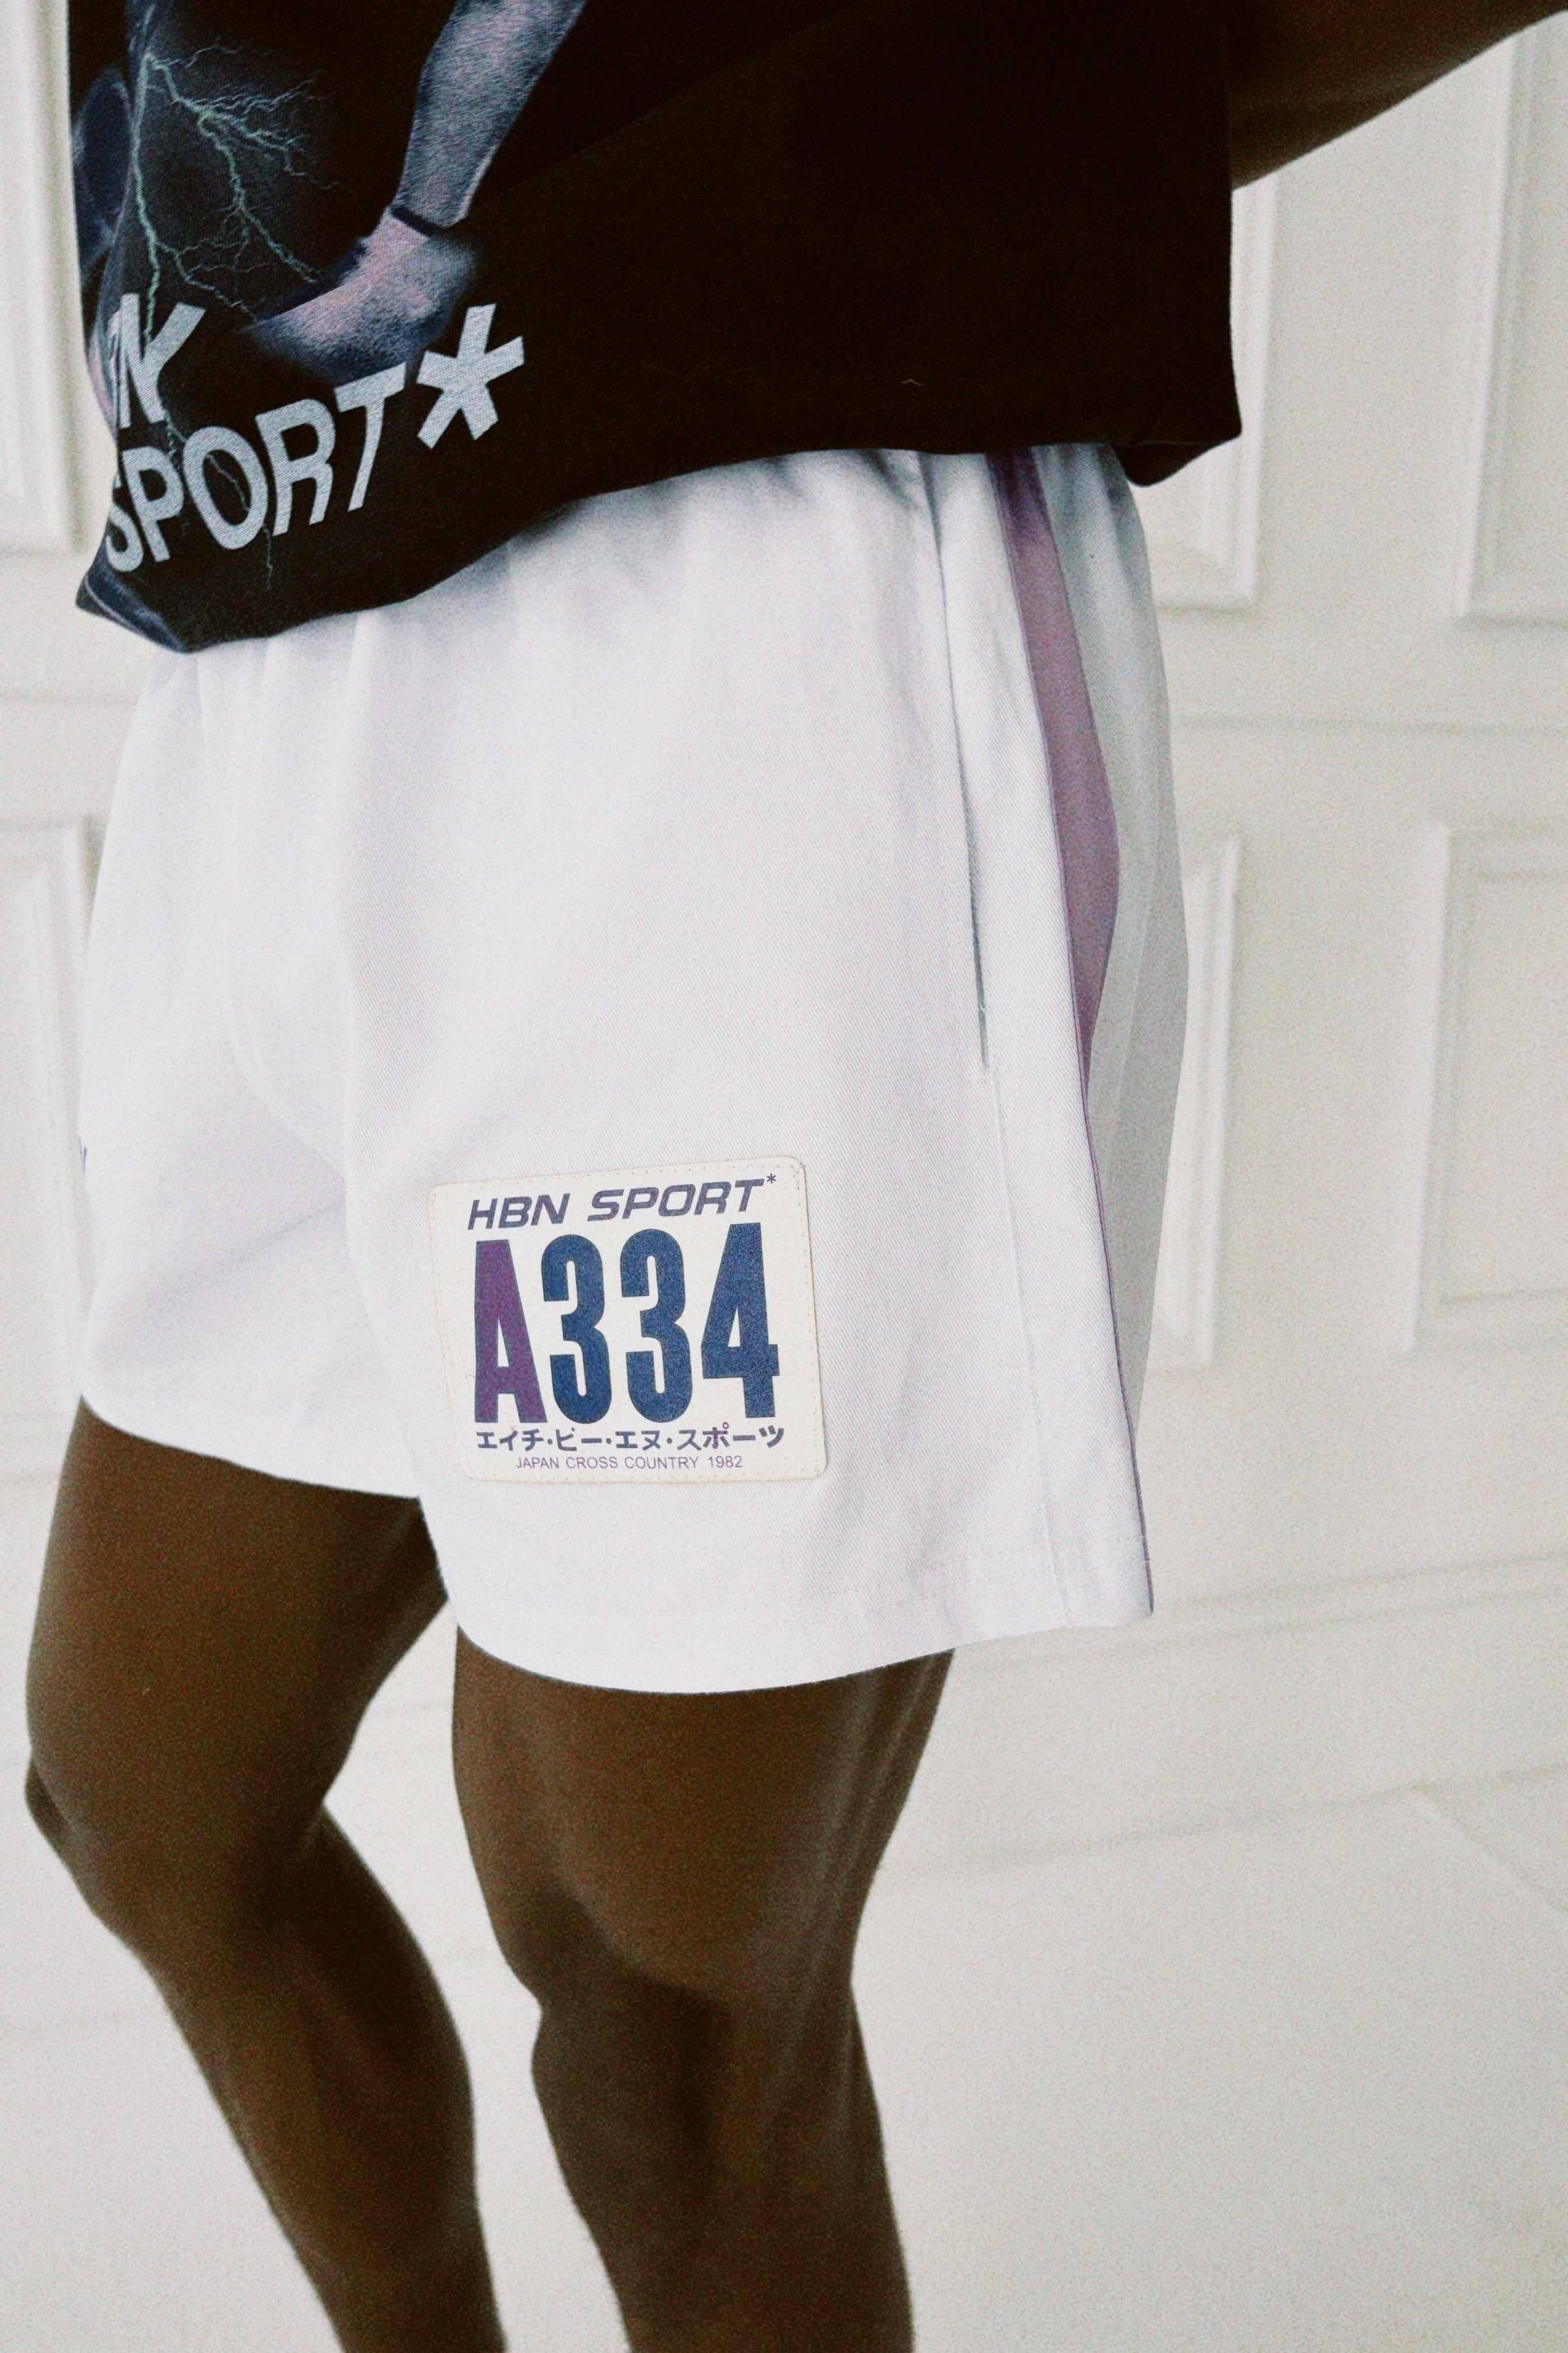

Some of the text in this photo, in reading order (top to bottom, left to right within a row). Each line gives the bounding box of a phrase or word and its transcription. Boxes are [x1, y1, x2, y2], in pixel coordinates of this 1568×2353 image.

[467, 1193, 570, 1230] HBN
[474, 1222, 780, 1425] A334
[516, 1455, 743, 1469] JAPAN CROSS COUNTRY 1982
